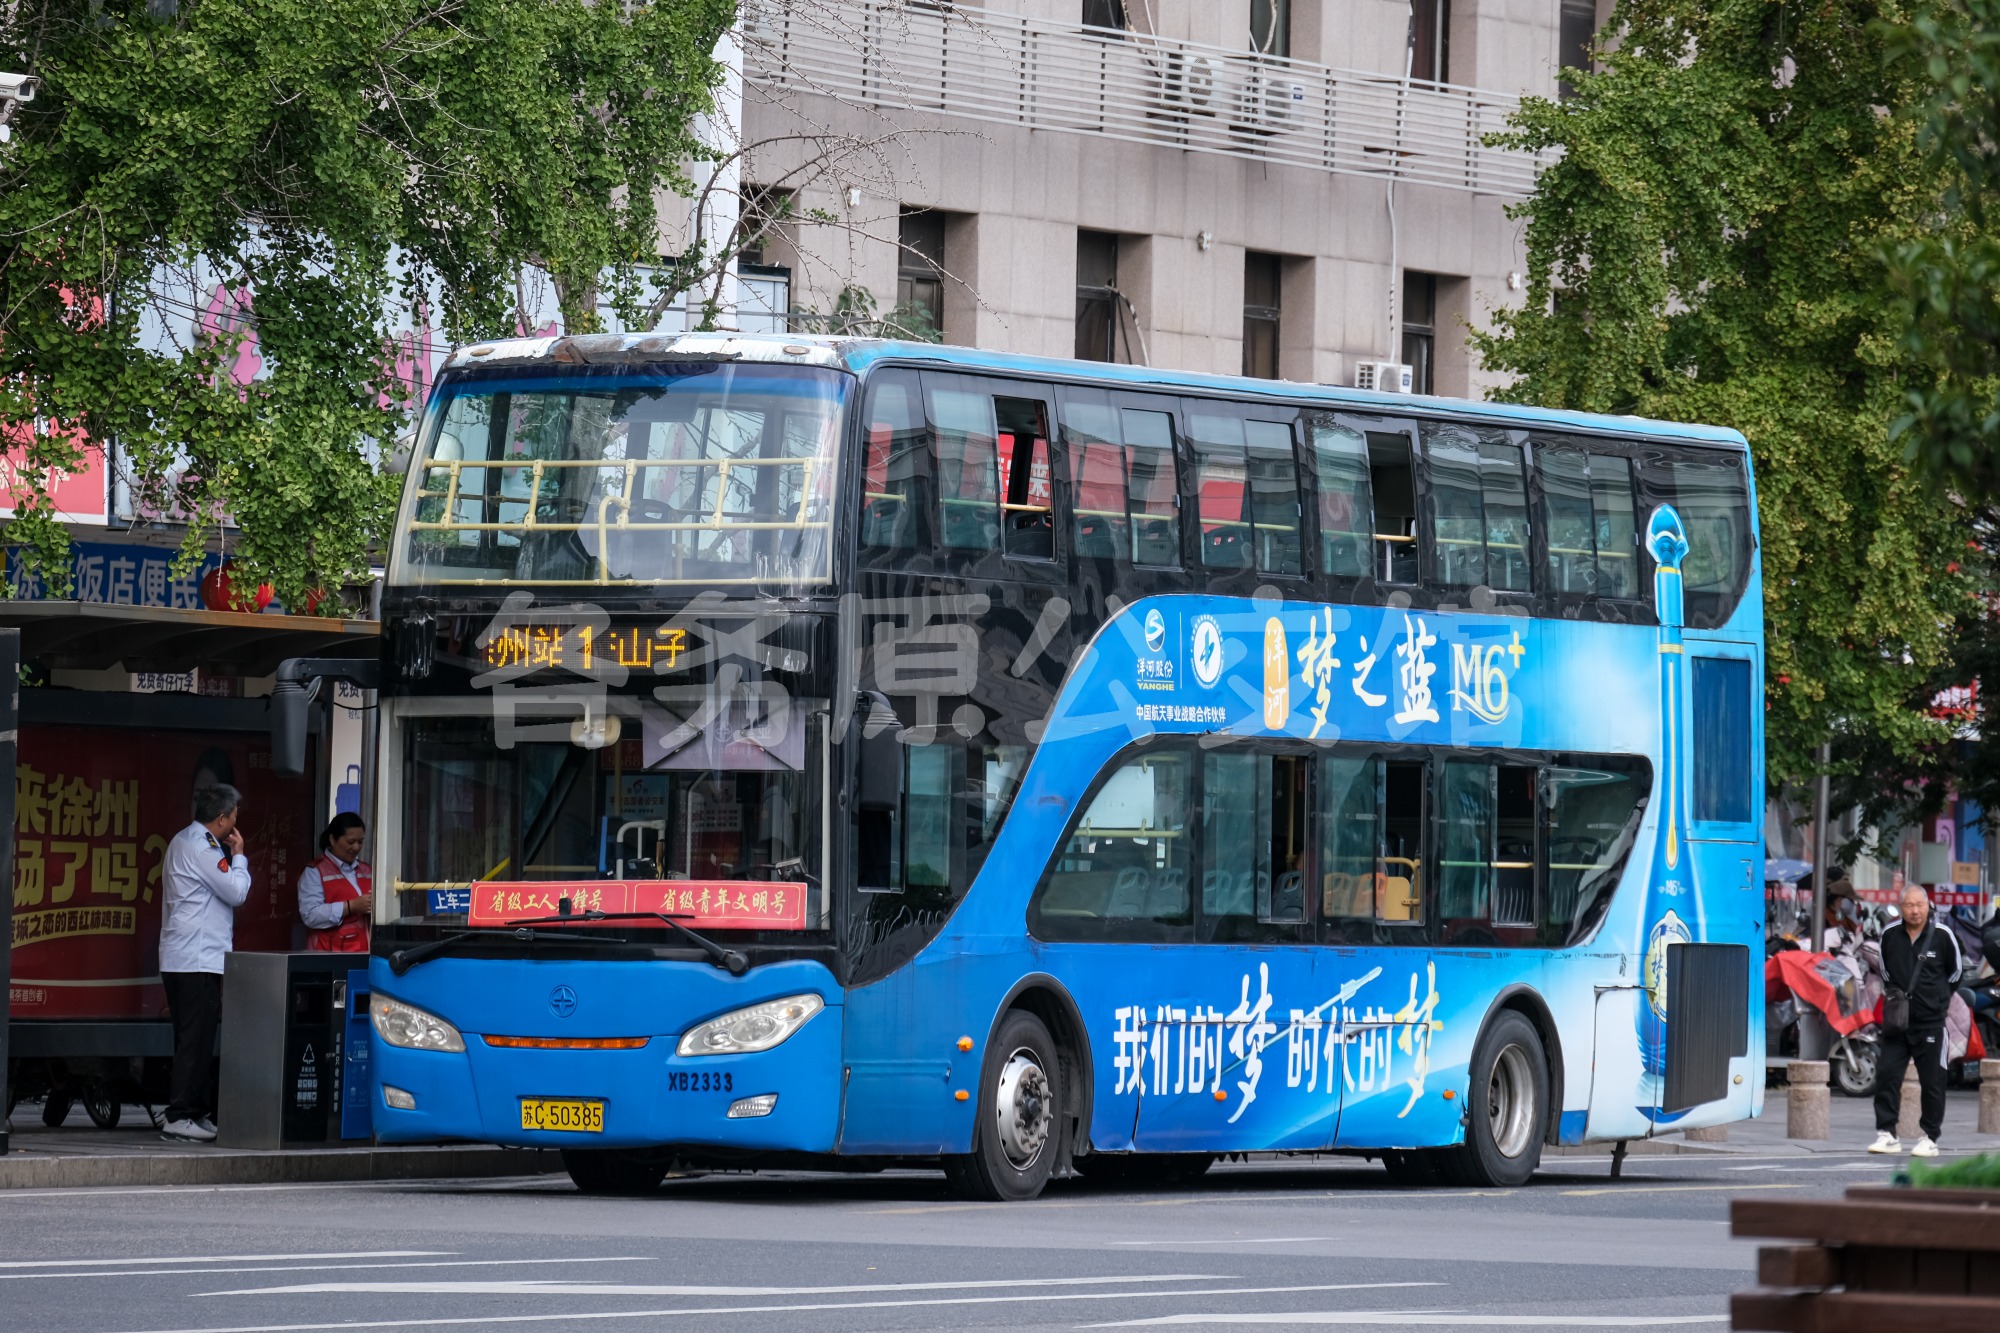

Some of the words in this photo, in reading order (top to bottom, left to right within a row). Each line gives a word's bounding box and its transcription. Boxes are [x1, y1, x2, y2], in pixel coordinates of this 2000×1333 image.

[578, 625, 593, 670] 1
[1137, 658, 1174, 680] 洋河股份
[1297, 606, 1440, 740] 梦之蓝
[1137, 682, 1175, 691] YANGHE
[1136, 704, 1227, 723] 中国航天事业战略合作伙伴
[16, 763, 139, 838] 来徐州
[434, 891, 471, 912] 上车二
[659, 888, 786, 916] 省级青年文明号
[1113, 961, 1276, 1124] 我们的梦
[1287, 960, 1444, 1119] 时代的梦
[668, 1071, 734, 1093] XB2333
